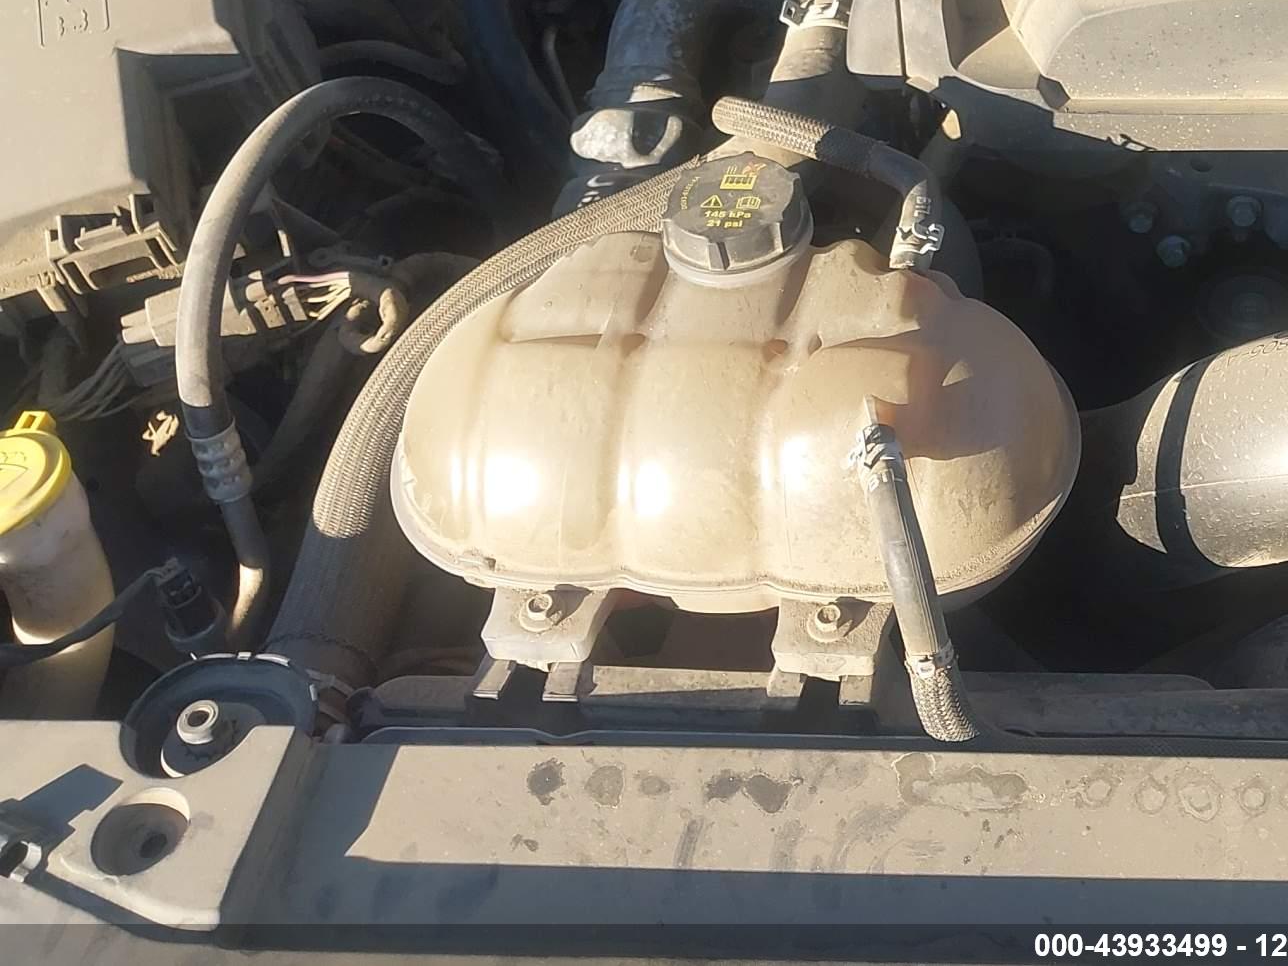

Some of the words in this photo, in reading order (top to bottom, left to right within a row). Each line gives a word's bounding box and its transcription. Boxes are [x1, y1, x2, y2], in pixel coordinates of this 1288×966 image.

[704, 210, 727, 218] 145
[729, 210, 752, 219] kPa
[706, 219, 721, 227] 21
[724, 219, 743, 228] psi
